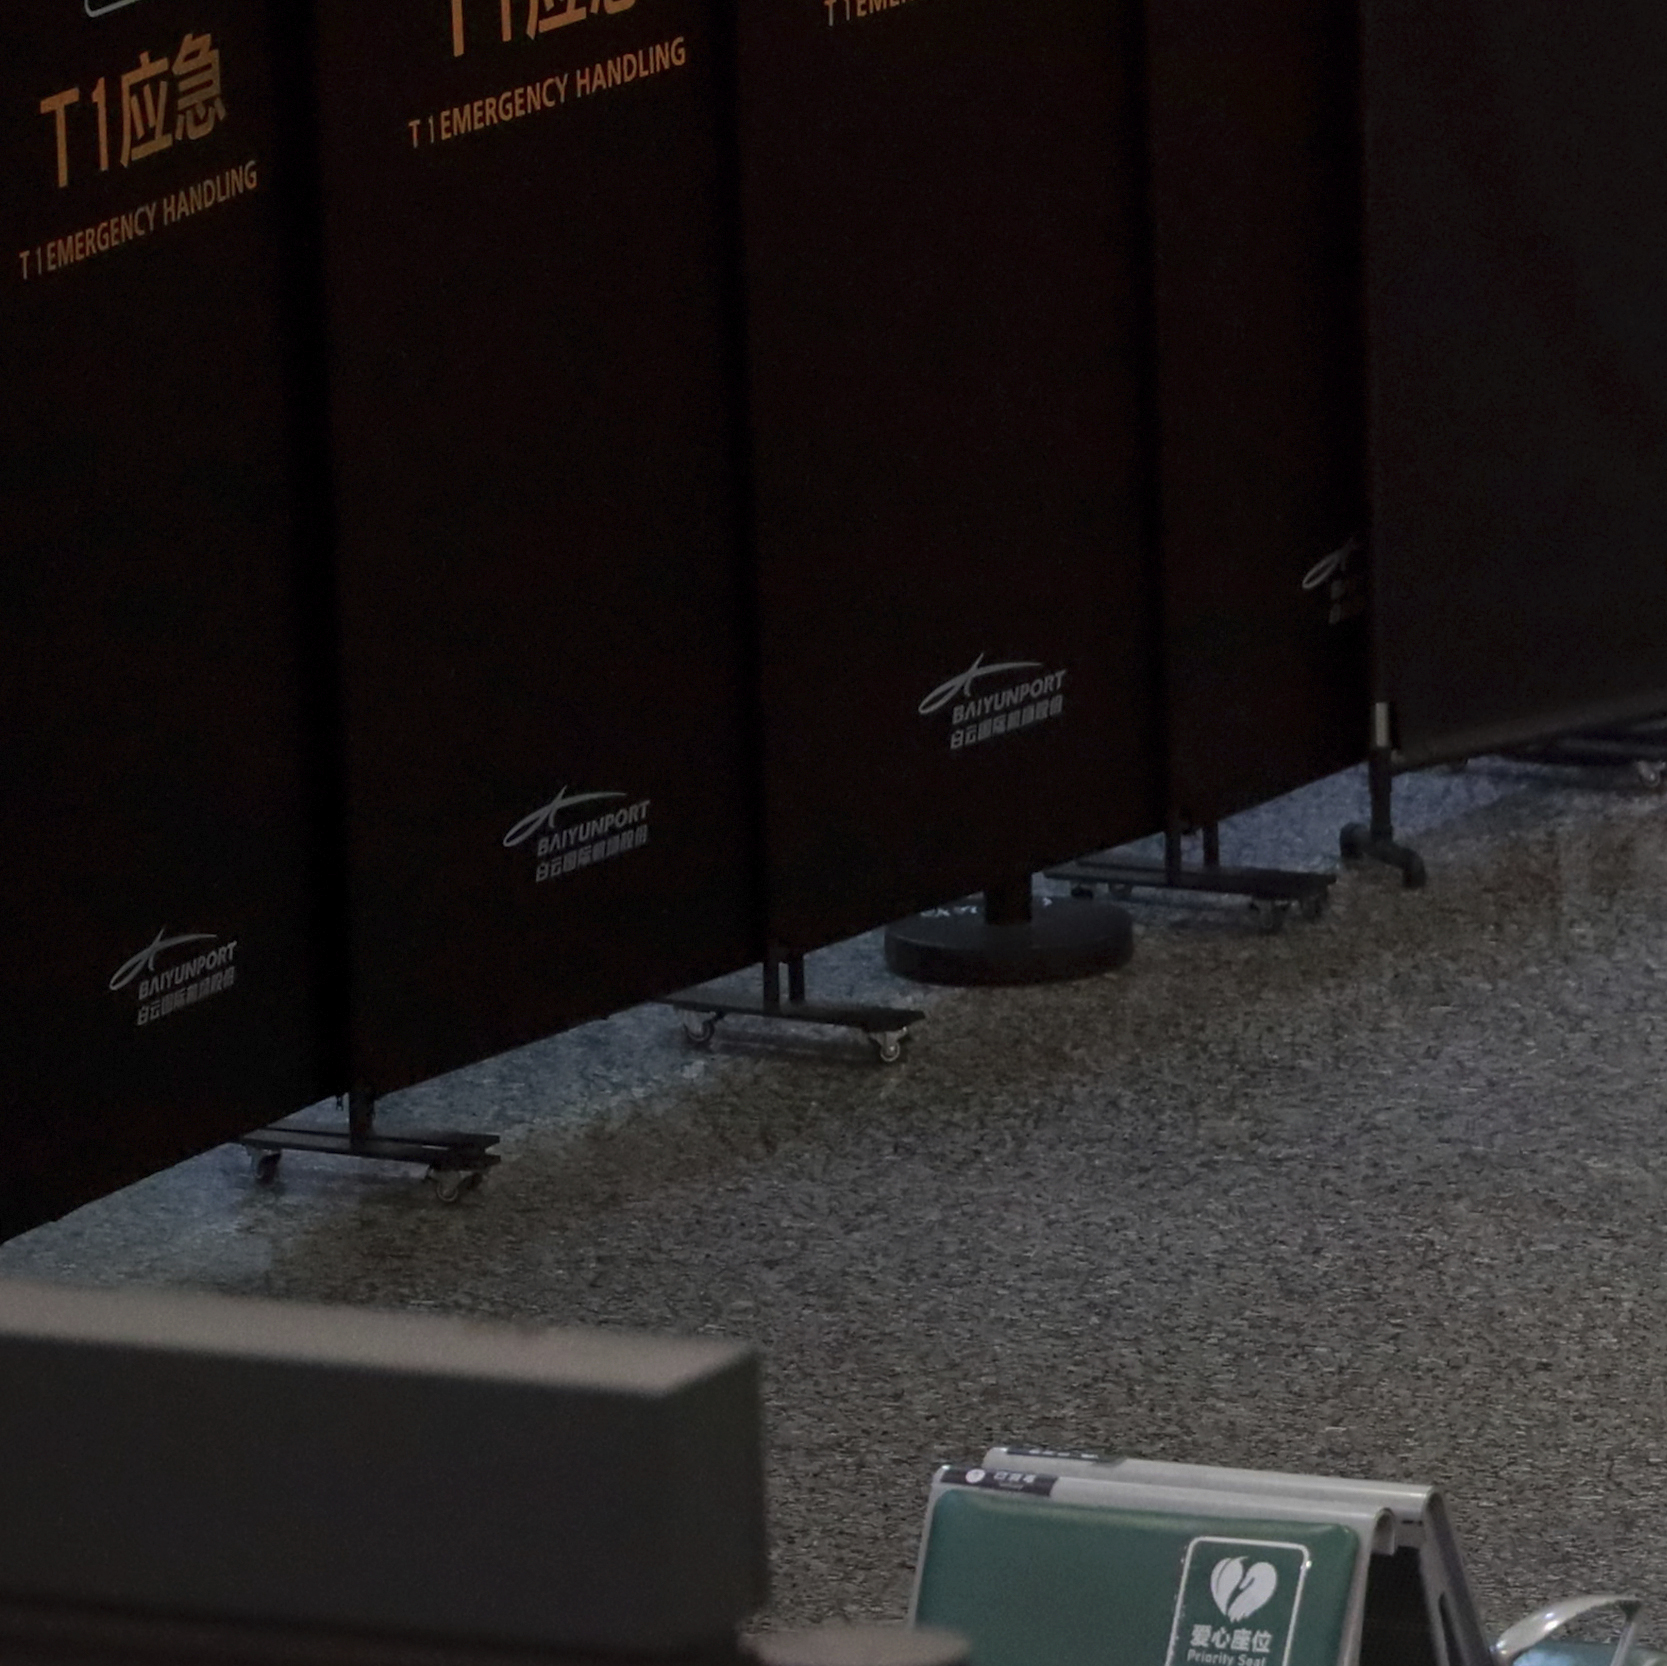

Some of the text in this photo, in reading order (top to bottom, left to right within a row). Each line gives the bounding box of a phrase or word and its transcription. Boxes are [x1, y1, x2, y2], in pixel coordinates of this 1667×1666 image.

[40, 33, 227, 188] T1应急
[440, 73, 569, 141] EMERGENCY
[576, 36, 687, 98] HANDLING
[47, 202, 157, 272] EMERGENCY
[163, 160, 258, 226] HANDLING
[952, 669, 1067, 725] BAIYUNPORT
[537, 800, 650, 857] BAIYUNPORT
[138, 940, 238, 1000] BAIYUNPORT
[1190, 1624, 1273, 1653] 爱心座位
